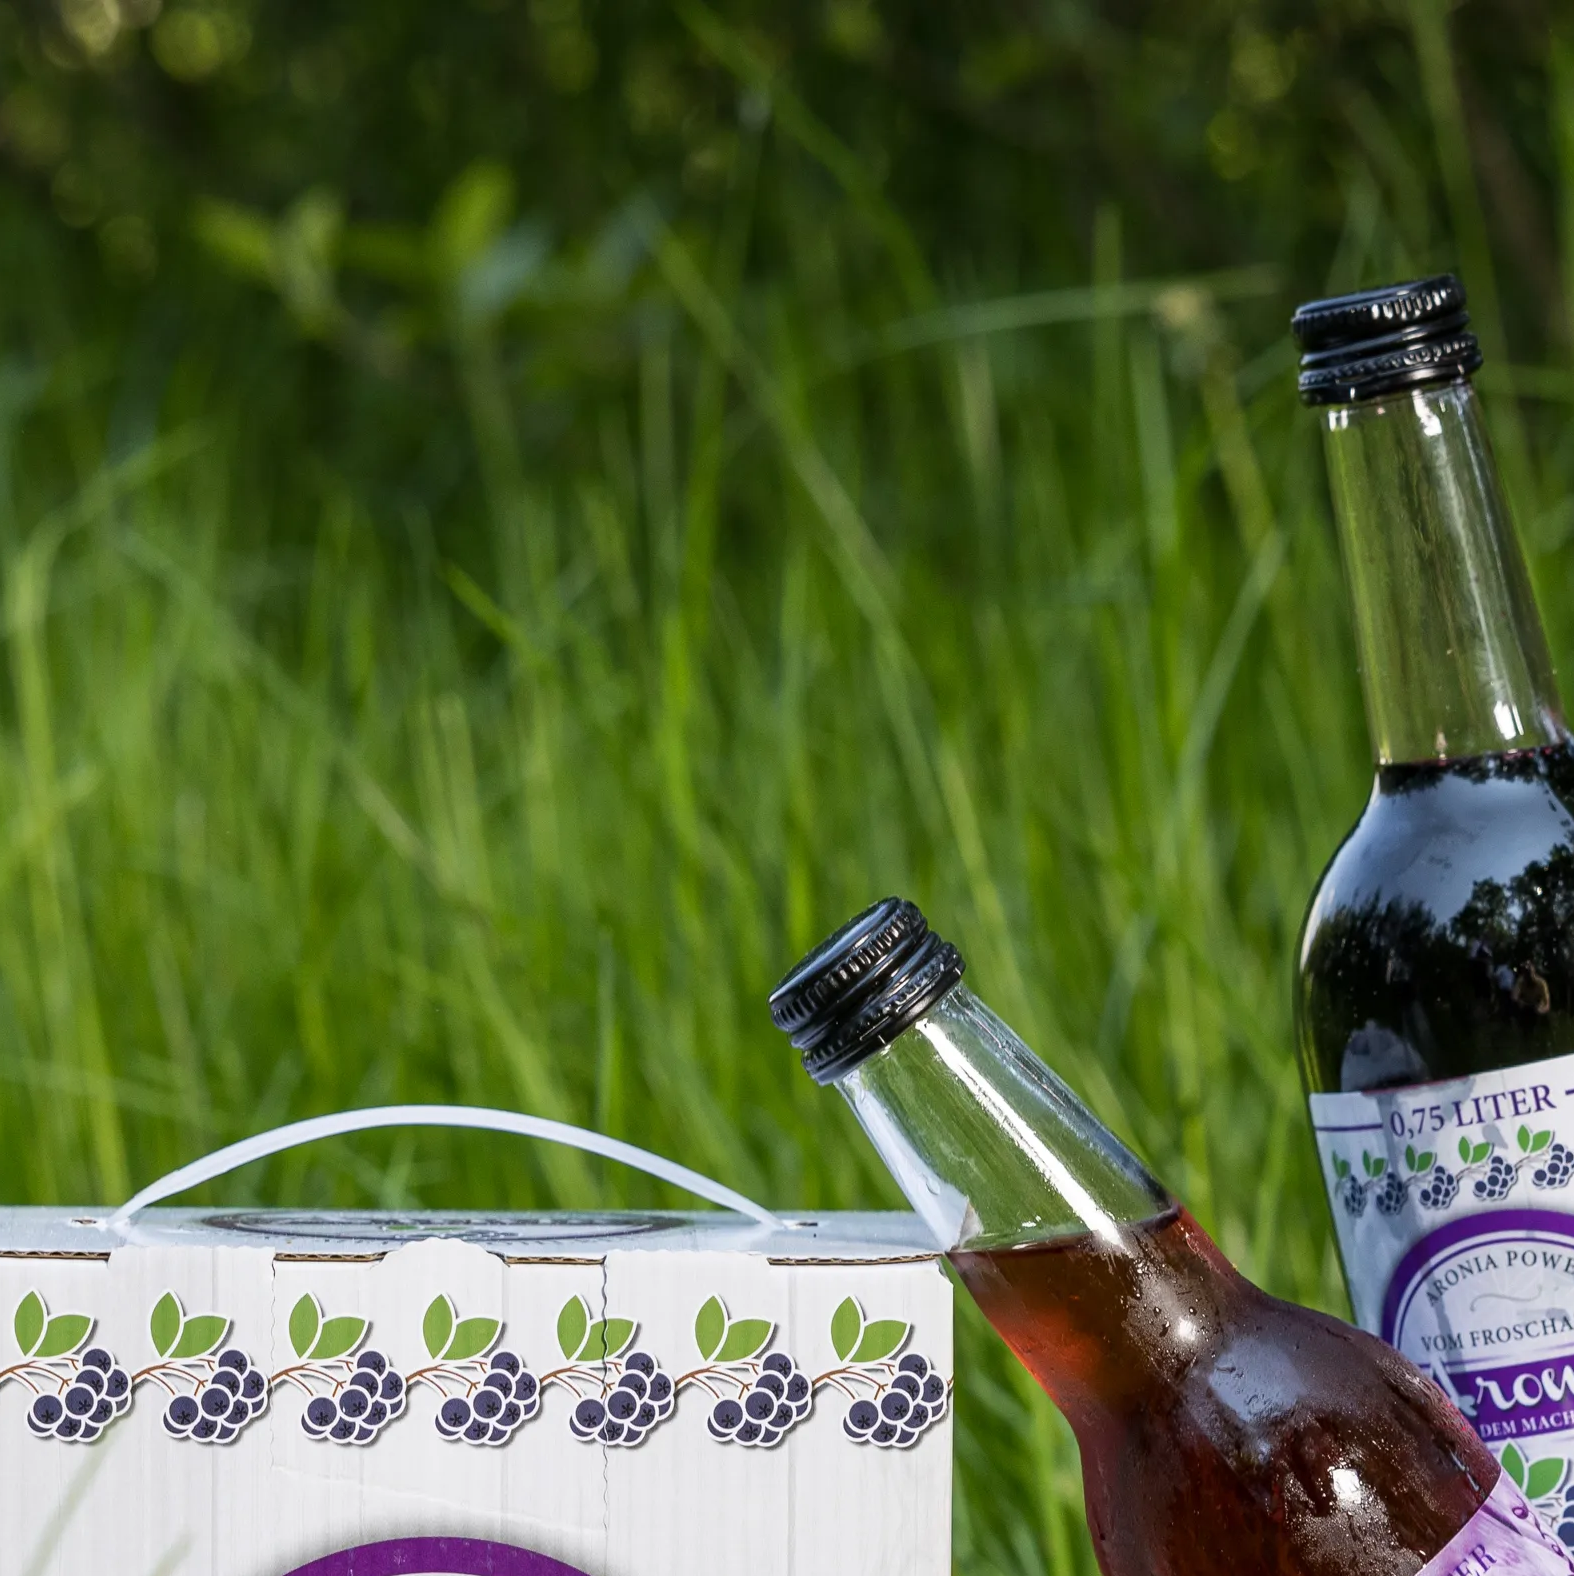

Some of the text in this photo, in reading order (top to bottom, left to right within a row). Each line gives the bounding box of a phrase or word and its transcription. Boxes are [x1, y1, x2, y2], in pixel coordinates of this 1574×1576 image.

[1390, 1084, 1557, 1141] 0,75 LITER
[1426, 1254, 1499, 1307] ARONIA
[1421, 1331, 1464, 1354] VOM
[1480, 1417, 1517, 1439] DEM
